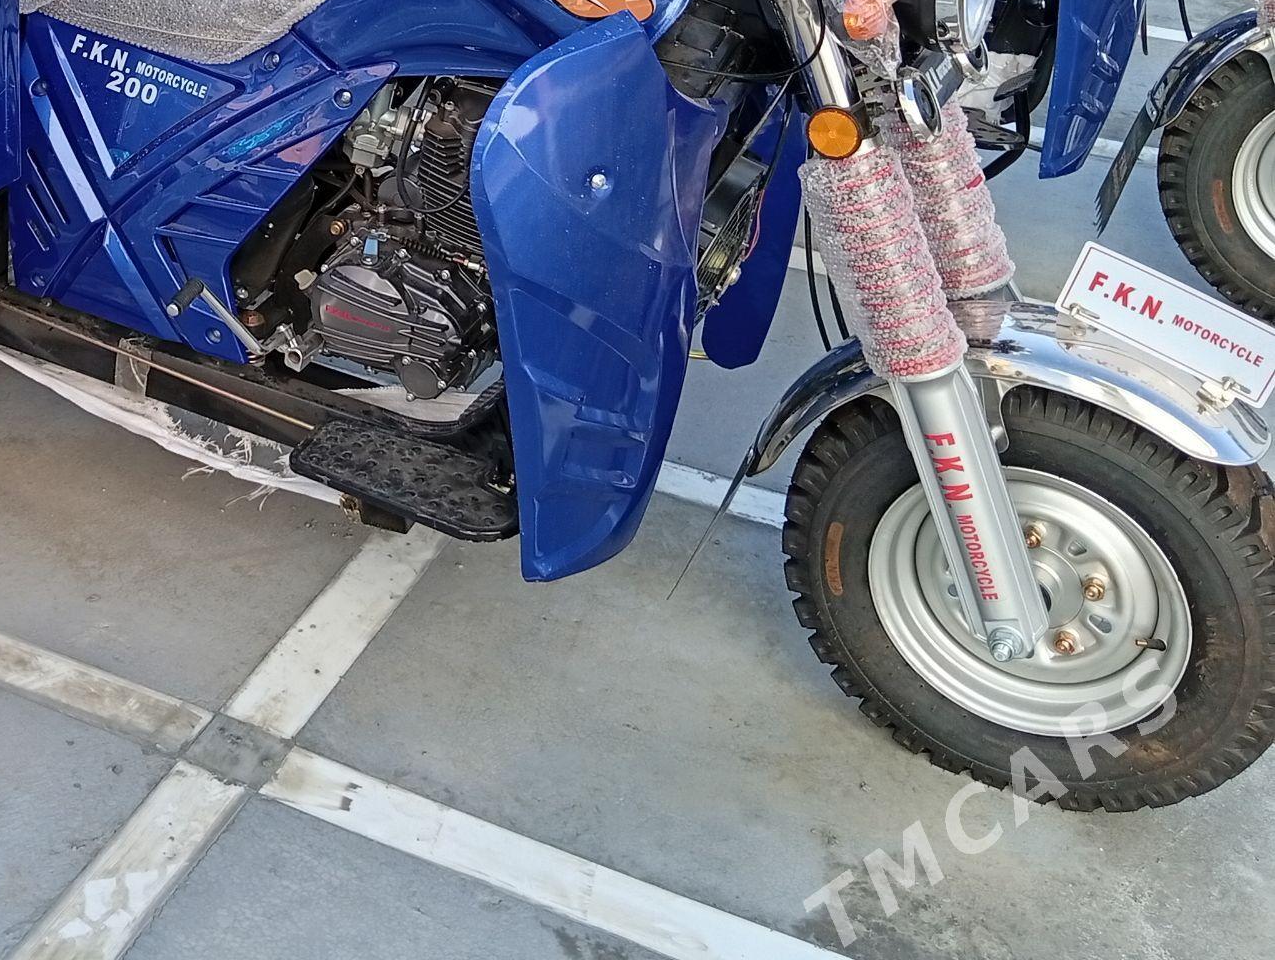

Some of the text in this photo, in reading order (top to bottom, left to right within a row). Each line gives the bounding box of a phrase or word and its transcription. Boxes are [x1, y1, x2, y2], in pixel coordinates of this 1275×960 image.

[70, 33, 208, 99] F.K.N. MOTORCYCLE
[105, 70, 158, 105] 200
[1088, 271, 1264, 368] F.K.N. MOTORCYCLE
[955, 514, 998, 601] MOTORCYCLE
